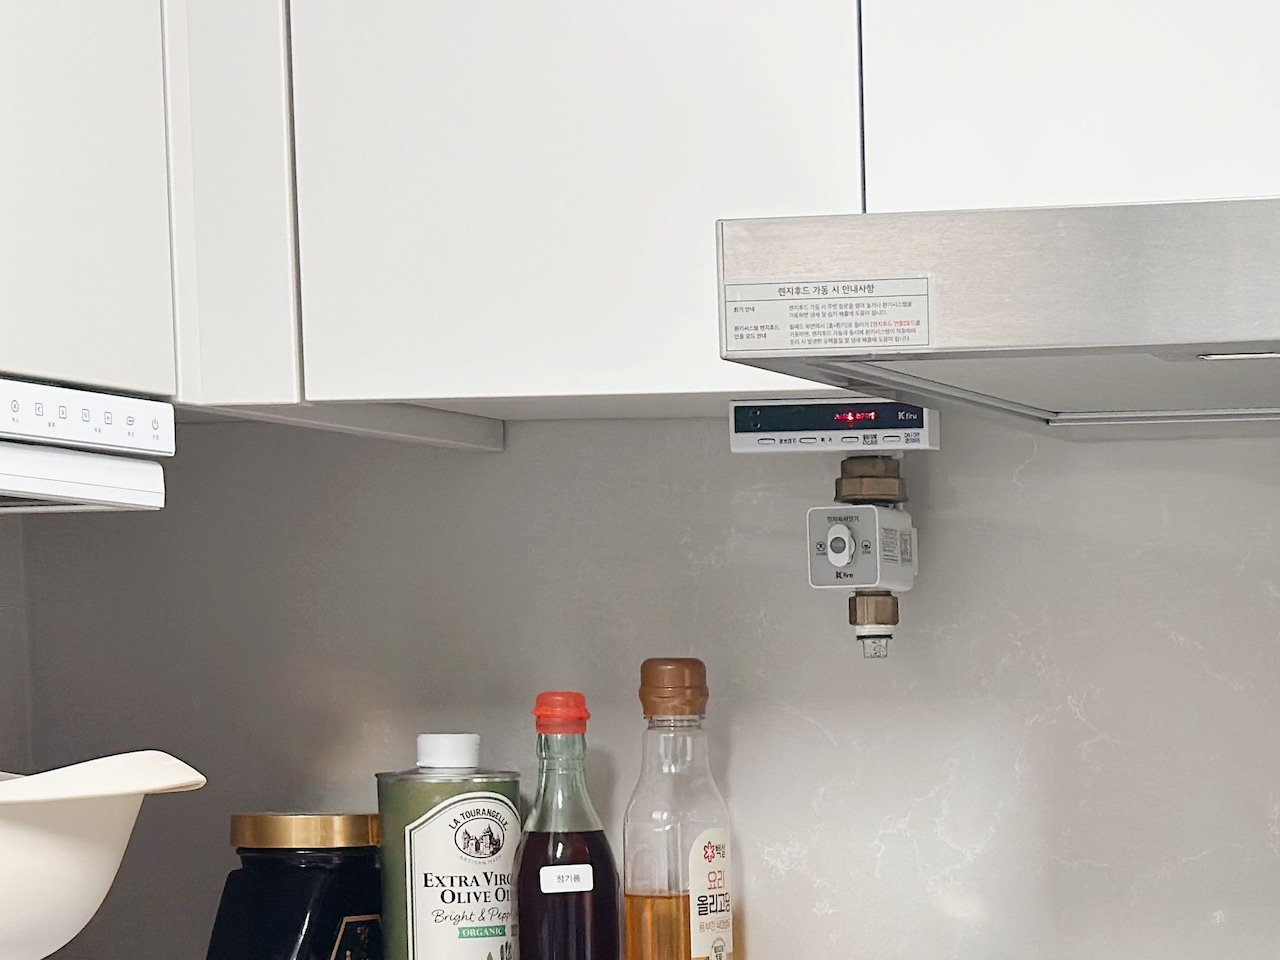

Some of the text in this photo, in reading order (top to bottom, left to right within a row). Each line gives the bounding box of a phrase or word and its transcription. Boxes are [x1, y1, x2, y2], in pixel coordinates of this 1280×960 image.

[778, 284, 875, 296] 렌지후드 가동 시 안내사항
[448, 808, 508, 831] LA TOURANGELLE
[423, 872, 480, 887] EXTRA
[707, 868, 725, 890] 요리
[440, 889, 491, 904] OLIVE
[431, 909, 476, 925] Bright
[478, 908, 486, 921] &
[462, 928, 503, 937] ORGANIC
